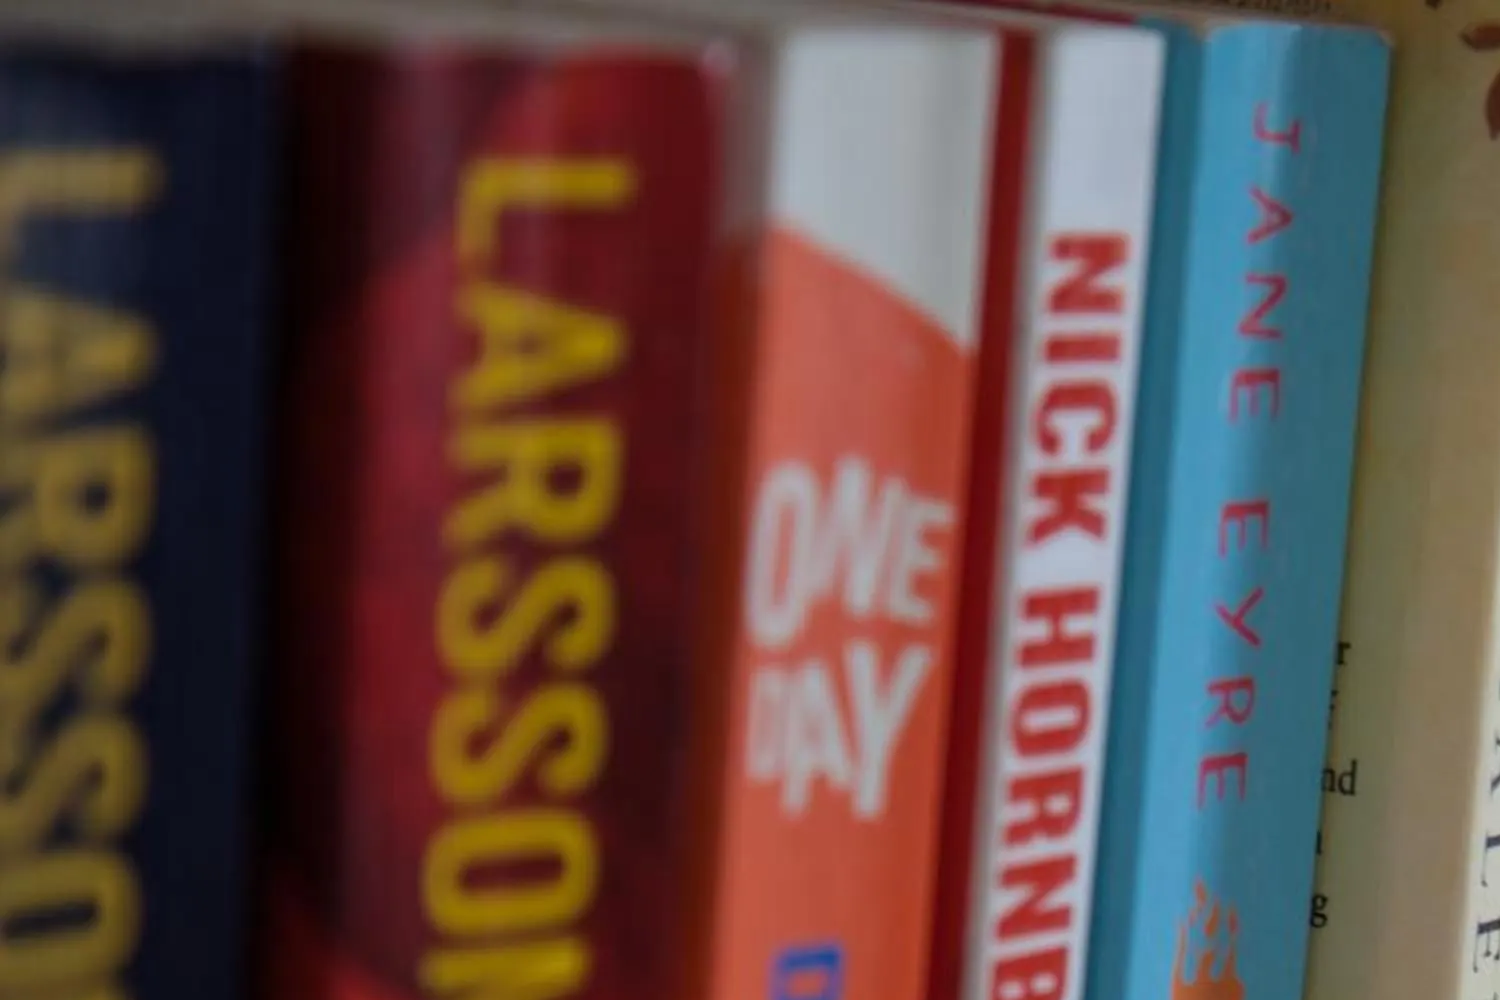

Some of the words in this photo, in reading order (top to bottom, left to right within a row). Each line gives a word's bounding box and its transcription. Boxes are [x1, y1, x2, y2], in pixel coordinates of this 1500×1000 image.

[1024, 231, 1133, 550] NICK
[1226, 103, 1303, 423] JANE
[743, 455, 957, 648] ONE
[1198, 497, 1270, 810] EYRE
[742, 642, 934, 820] DAY
